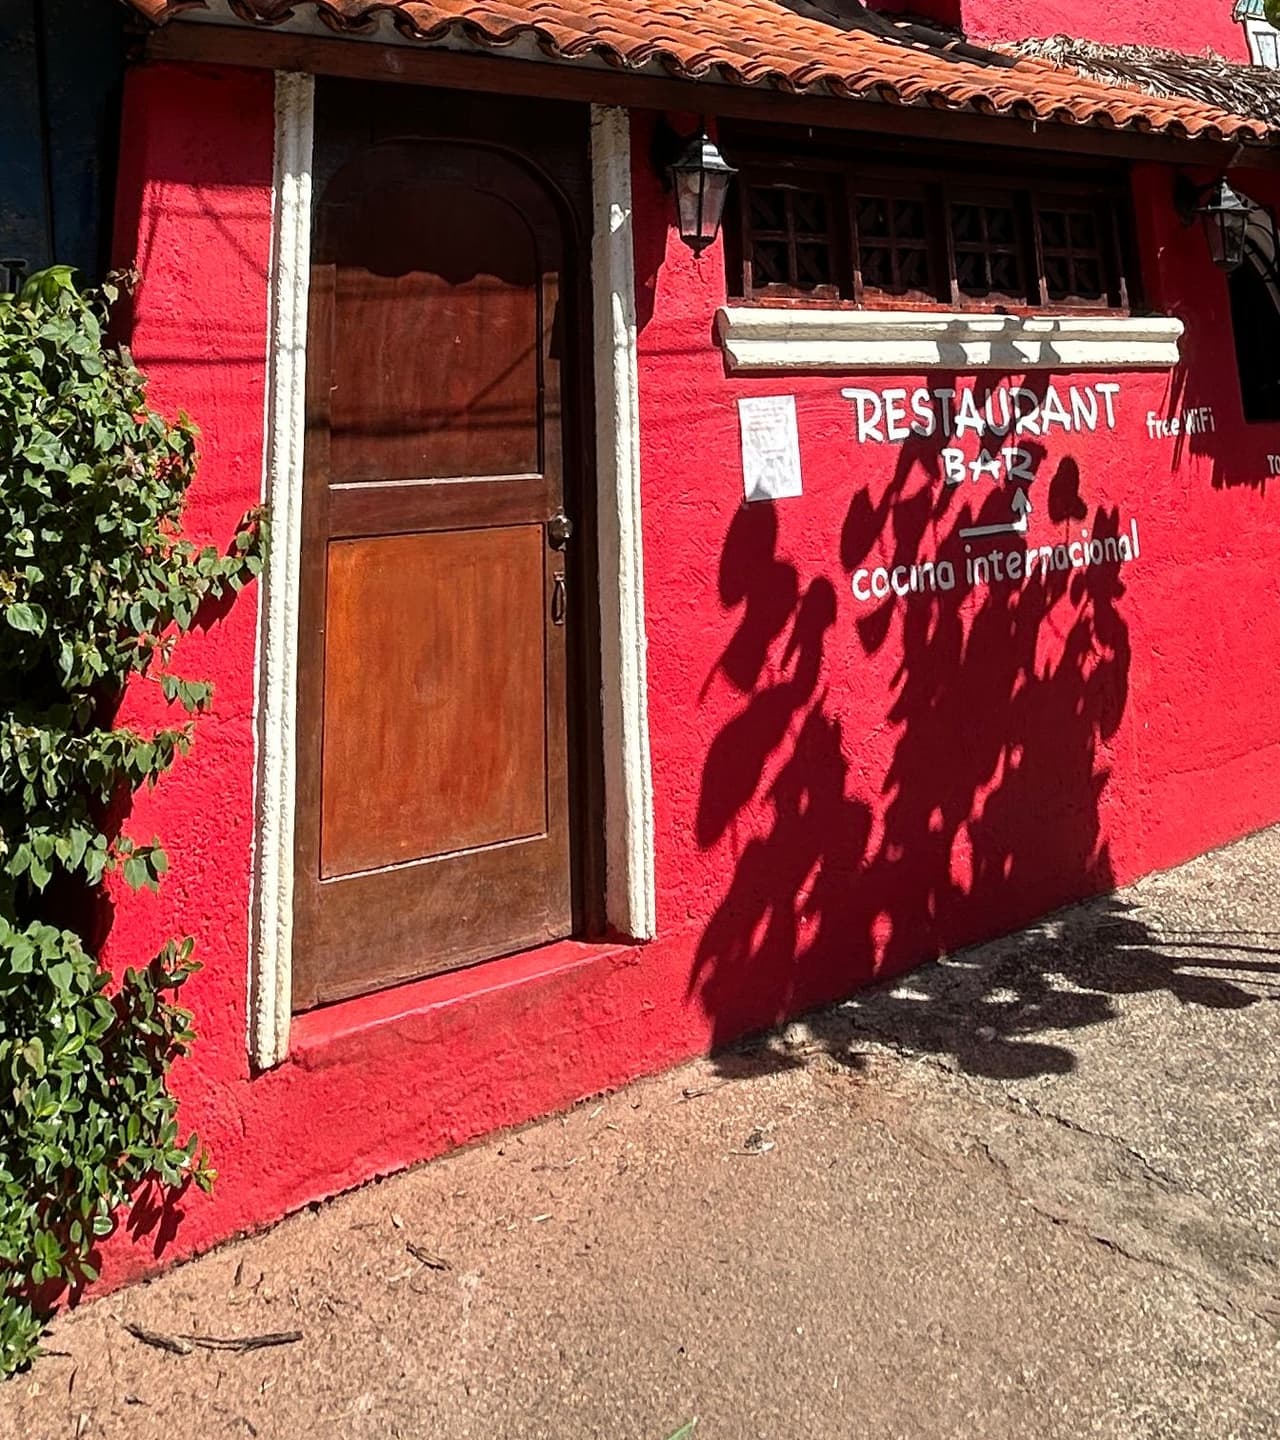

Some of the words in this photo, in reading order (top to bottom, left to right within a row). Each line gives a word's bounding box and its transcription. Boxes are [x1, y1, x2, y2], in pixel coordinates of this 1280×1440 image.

[841, 383, 1121, 444] RESTAURANT
[1146, 411, 1180, 440] free
[1181, 407, 1216, 436] WiFi
[941, 446, 1035, 485] BAR
[851, 558, 957, 602] cocina
[965, 516, 1142, 587] internacional
